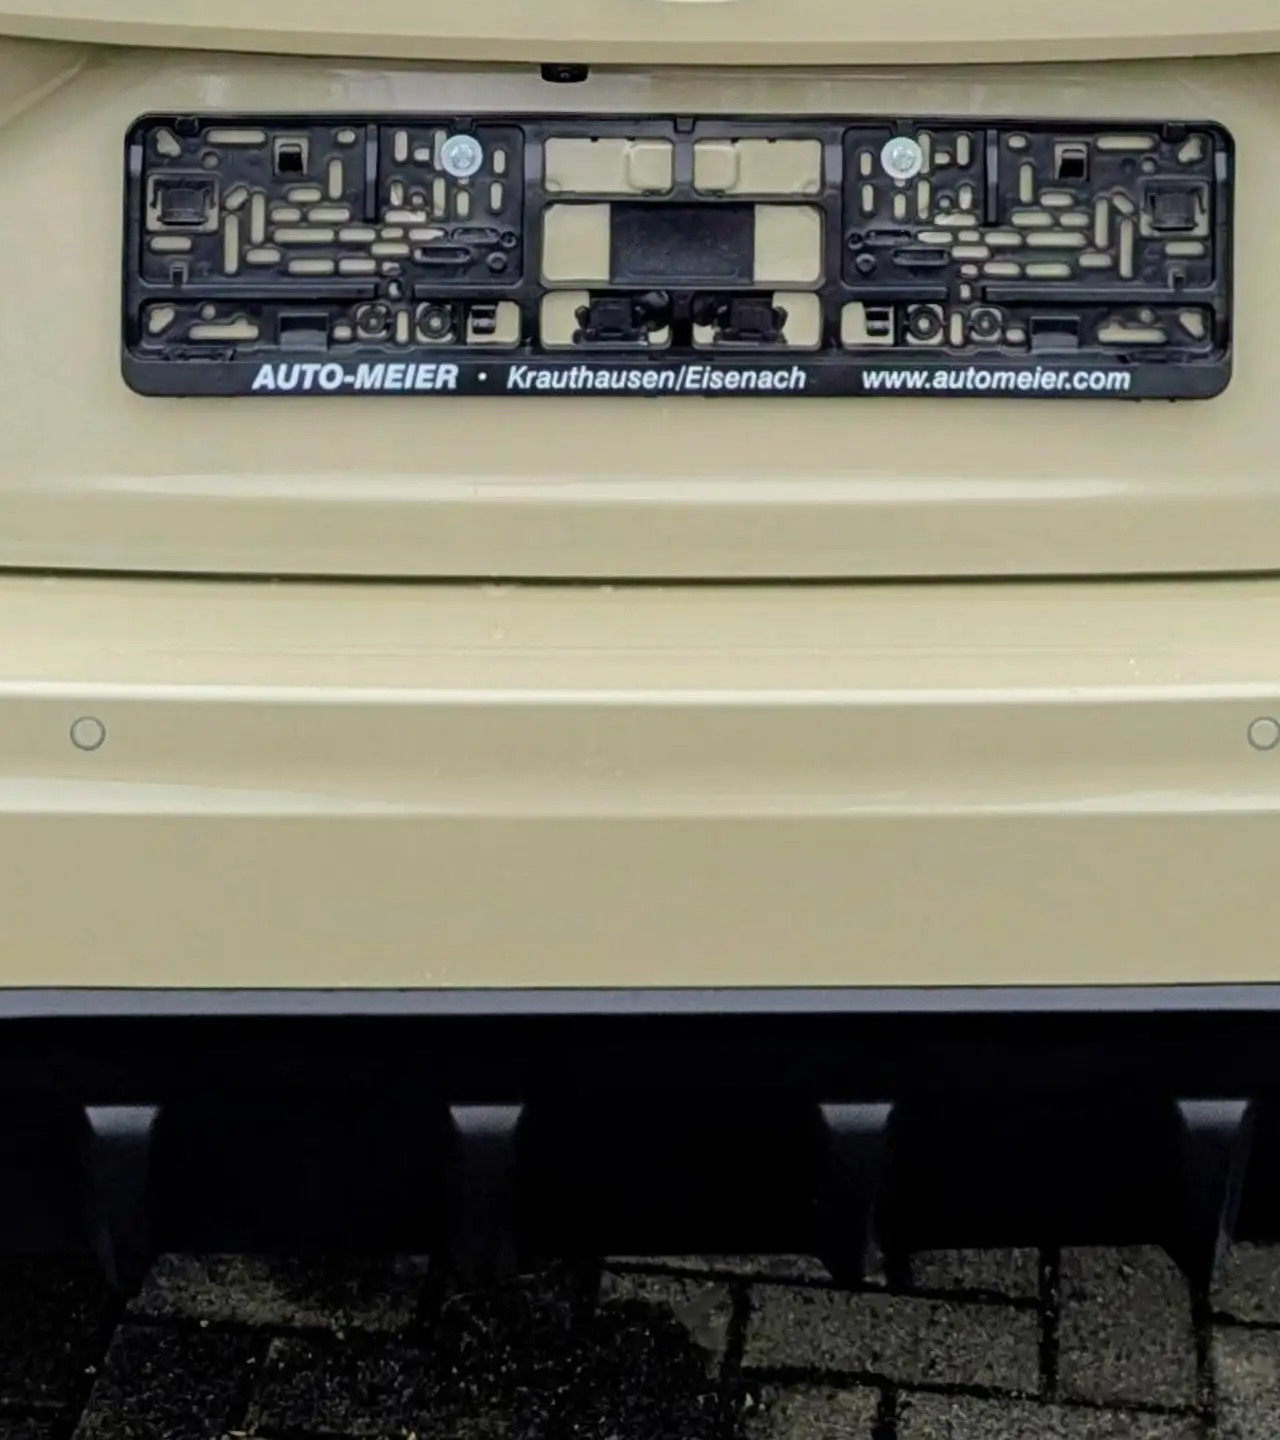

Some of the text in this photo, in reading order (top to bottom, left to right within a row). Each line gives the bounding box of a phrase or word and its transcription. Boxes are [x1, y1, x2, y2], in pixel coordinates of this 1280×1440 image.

[252, 362, 1132, 393] AUTO-MEIER Krauthausen/Eisenach www.automeier.com
